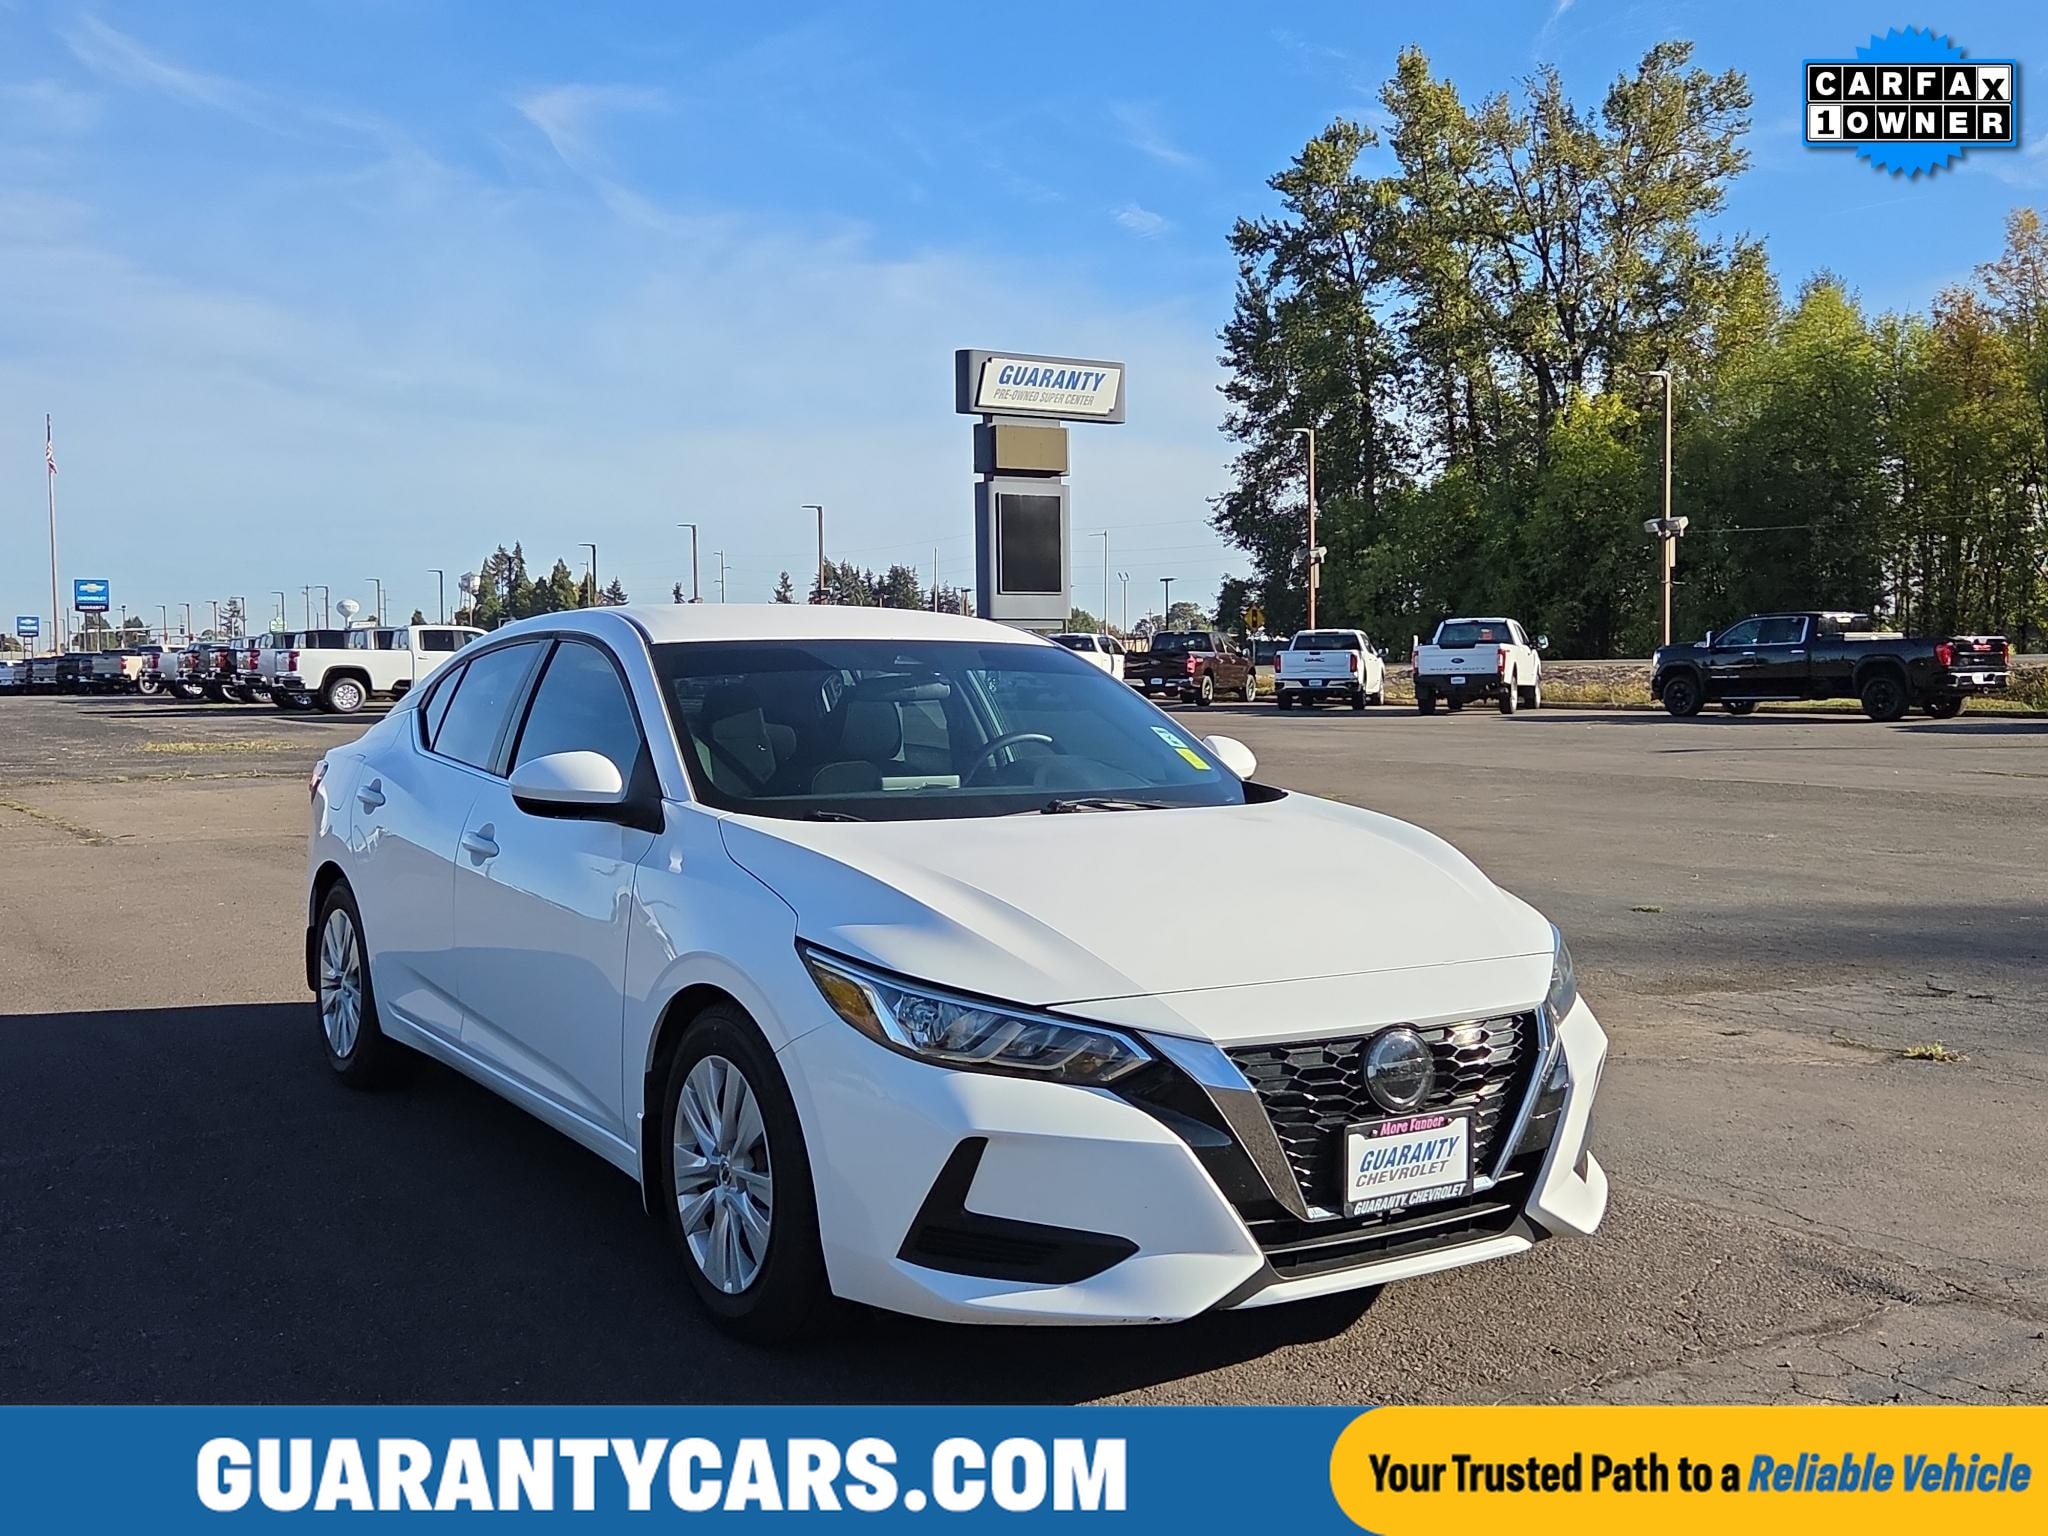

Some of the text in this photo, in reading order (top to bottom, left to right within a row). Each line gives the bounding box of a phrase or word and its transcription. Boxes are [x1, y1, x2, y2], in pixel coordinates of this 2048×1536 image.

[999, 365, 1106, 391] GUARANTY
[993, 388, 1095, 406] PRE-OWNED SUPER CENTER
[1380, 1122, 1407, 1136] More
[1360, 1136, 1460, 1173] GUARANTY
[1355, 1160, 1449, 1187] CHEVROLET
[1353, 1183, 1466, 1216] GUARANTY CHEVROLET
